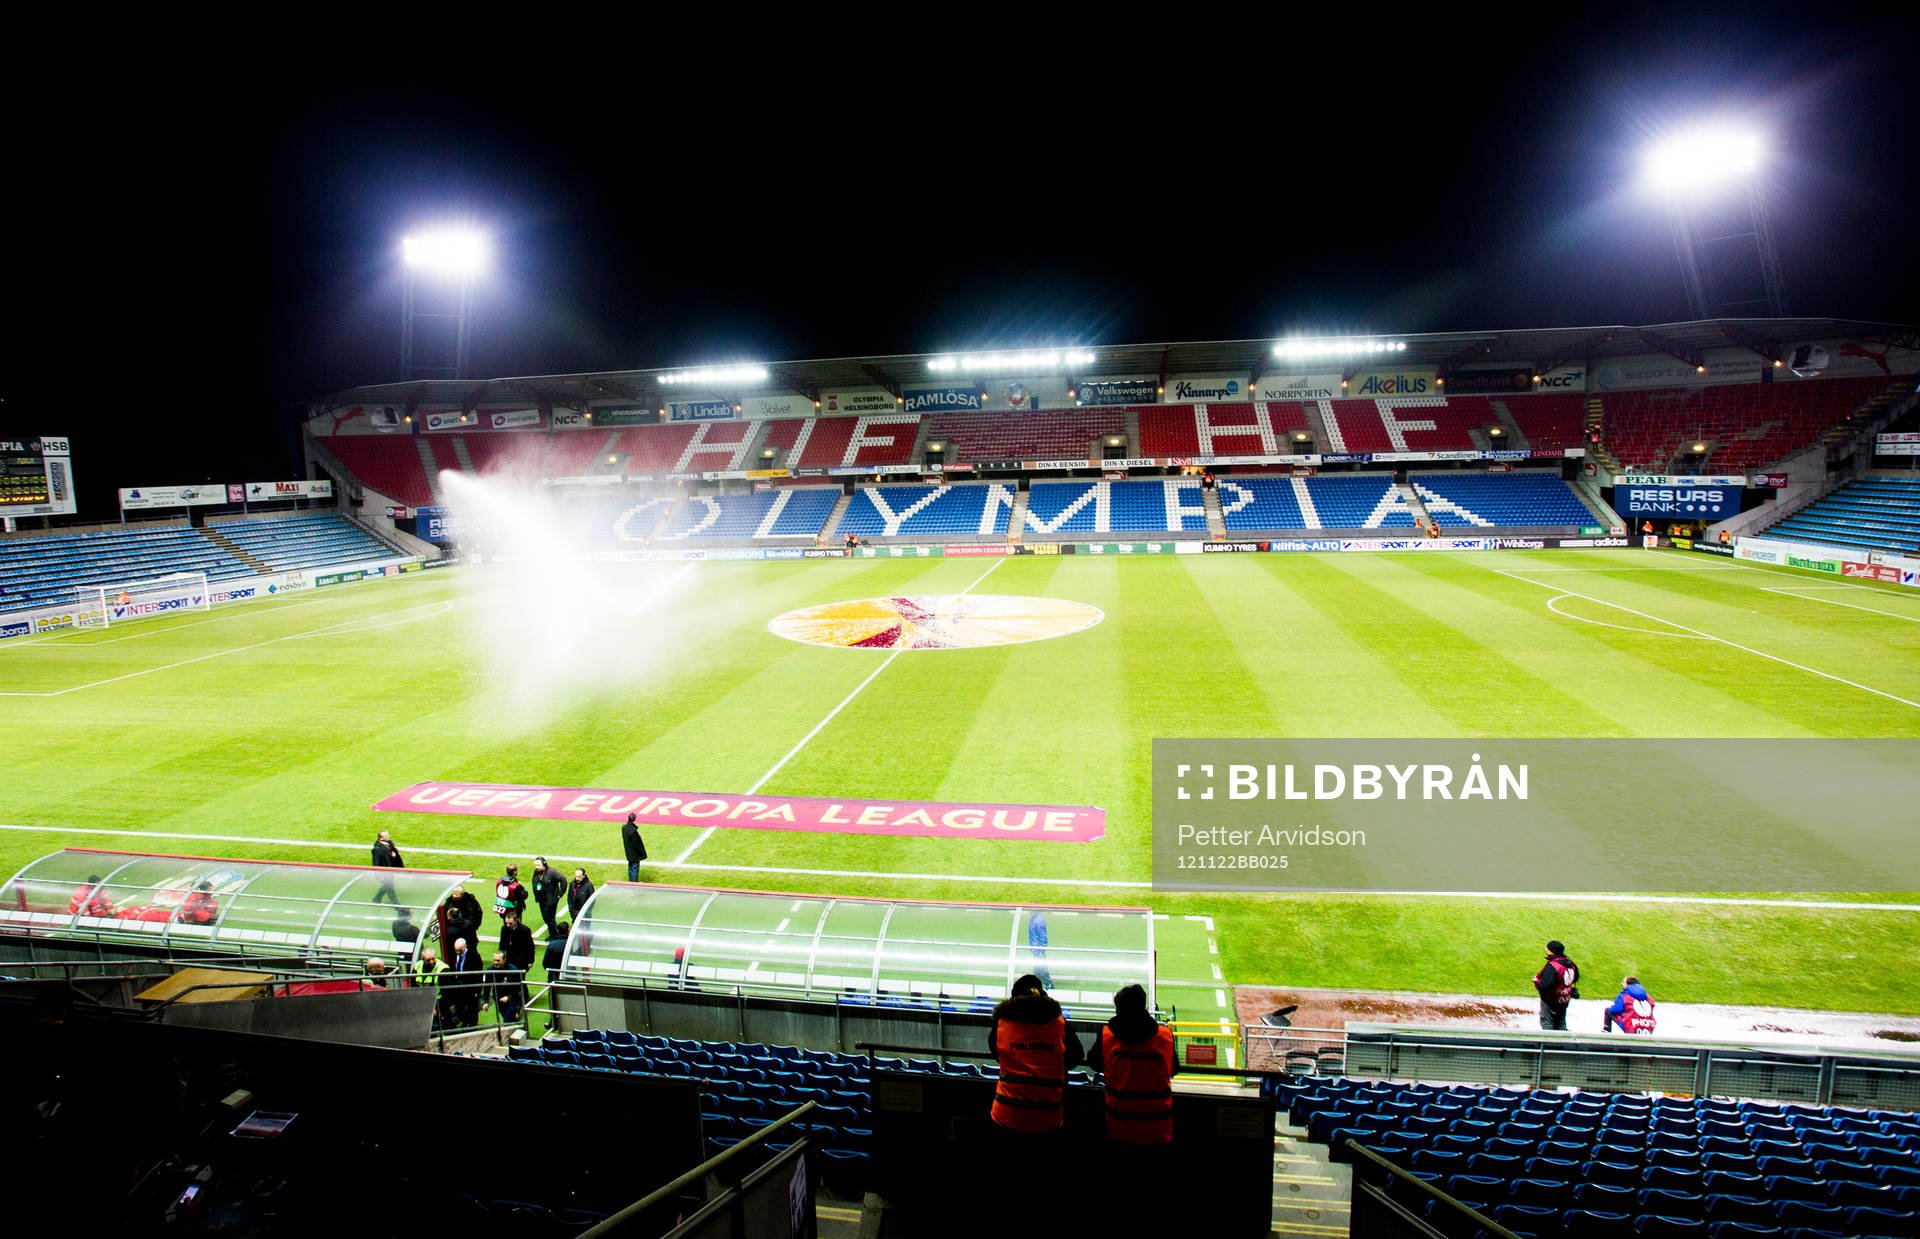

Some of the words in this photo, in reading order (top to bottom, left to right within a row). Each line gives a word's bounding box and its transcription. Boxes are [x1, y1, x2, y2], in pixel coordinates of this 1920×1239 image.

[1358, 375, 1427, 395] Akelius
[1540, 376, 1572, 388] NCC
[1097, 385, 1154, 396] Volkswagen
[1264, 388, 1333, 399] NORRPORTEN
[905, 389, 979, 411] RAMLÖSA
[693, 402, 731, 417] Lindab
[844, 403, 894, 411] HELSINGBORG
[554, 415, 579, 425] NCC
[0, 442, 24, 451] PIA
[43, 442, 69, 451] HSB
[1437, 451, 1477, 460] Scandlines
[1625, 476, 1667, 484] PEAB
[1629, 489, 1724, 503] RESURS
[1629, 502, 1681, 512] BANK
[1272, 541, 1339, 551] Nilfisk-ALTO
[1352, 541, 1409, 550] INTERSPORT
[1423, 540, 1481, 549] INTERSPORT
[1503, 539, 1545, 549] Wihlborgs
[1594, 537, 1629, 547] adidas
[1203, 543, 1233, 552] KUMHO
[1233, 544, 1258, 552] TYRES
[127, 598, 189, 616] INTERSPORT
[409, 786, 547, 812] UEFA
[562, 793, 797, 823] EUROPA
[818, 804, 1077, 832] LEAGUE
[1631, 1018, 1657, 1028] PHOTO
